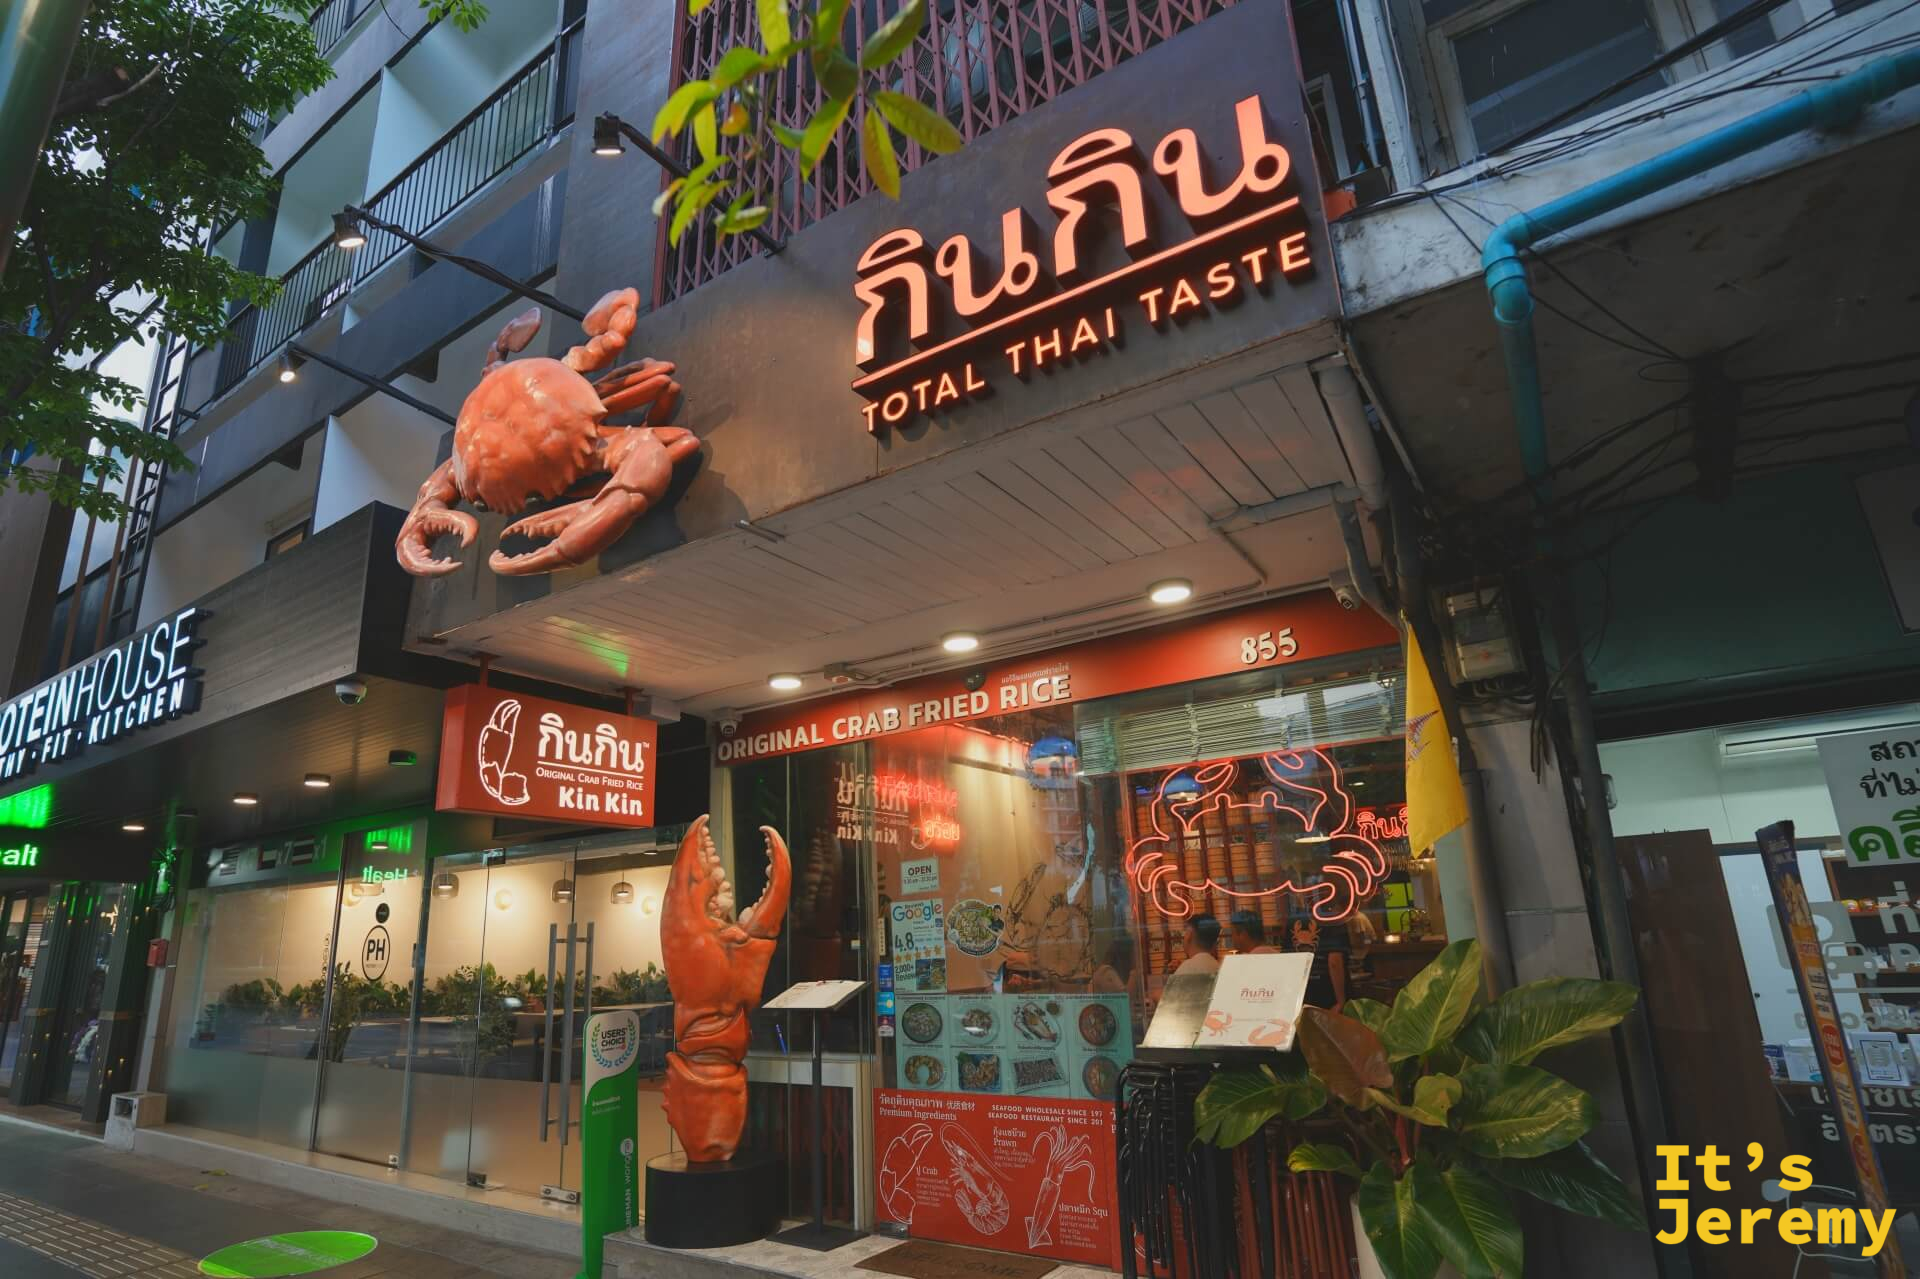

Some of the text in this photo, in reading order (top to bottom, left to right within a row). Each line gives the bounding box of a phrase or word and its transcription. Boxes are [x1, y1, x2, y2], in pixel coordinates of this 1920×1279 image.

[854, 95, 1290, 366] กินกิน
[862, 231, 1311, 432] TOTAL THAI TASTE
[1240, 627, 1297, 664] 855
[42, 730, 71, 763] FIT
[88, 678, 186, 745] KITCHEN
[718, 723, 825, 762] ORIGINAL
[832, 708, 900, 741] CRAB
[909, 690, 989, 726] FRIED
[1000, 673, 1072, 709] RICE
[538, 712, 645, 773] กินกิน
[536, 767, 644, 791] ORIGINAL CRAB FRIED RICE
[559, 786, 644, 816] Kin Kin
[0, 844, 39, 867] alt
[907, 865, 932, 876] OPEN
[892, 899, 943, 922] Google
[366, 939, 386, 961] PH
[880, 1107, 957, 1120] Premium Ingredients
[992, 1104, 1022, 1112] SEAFOOD
[1026, 1107, 1065, 1115] WHOLESALE
[1021, 1114, 1064, 1122] RESTAURANT
[993, 1137, 1017, 1148] Prawn
